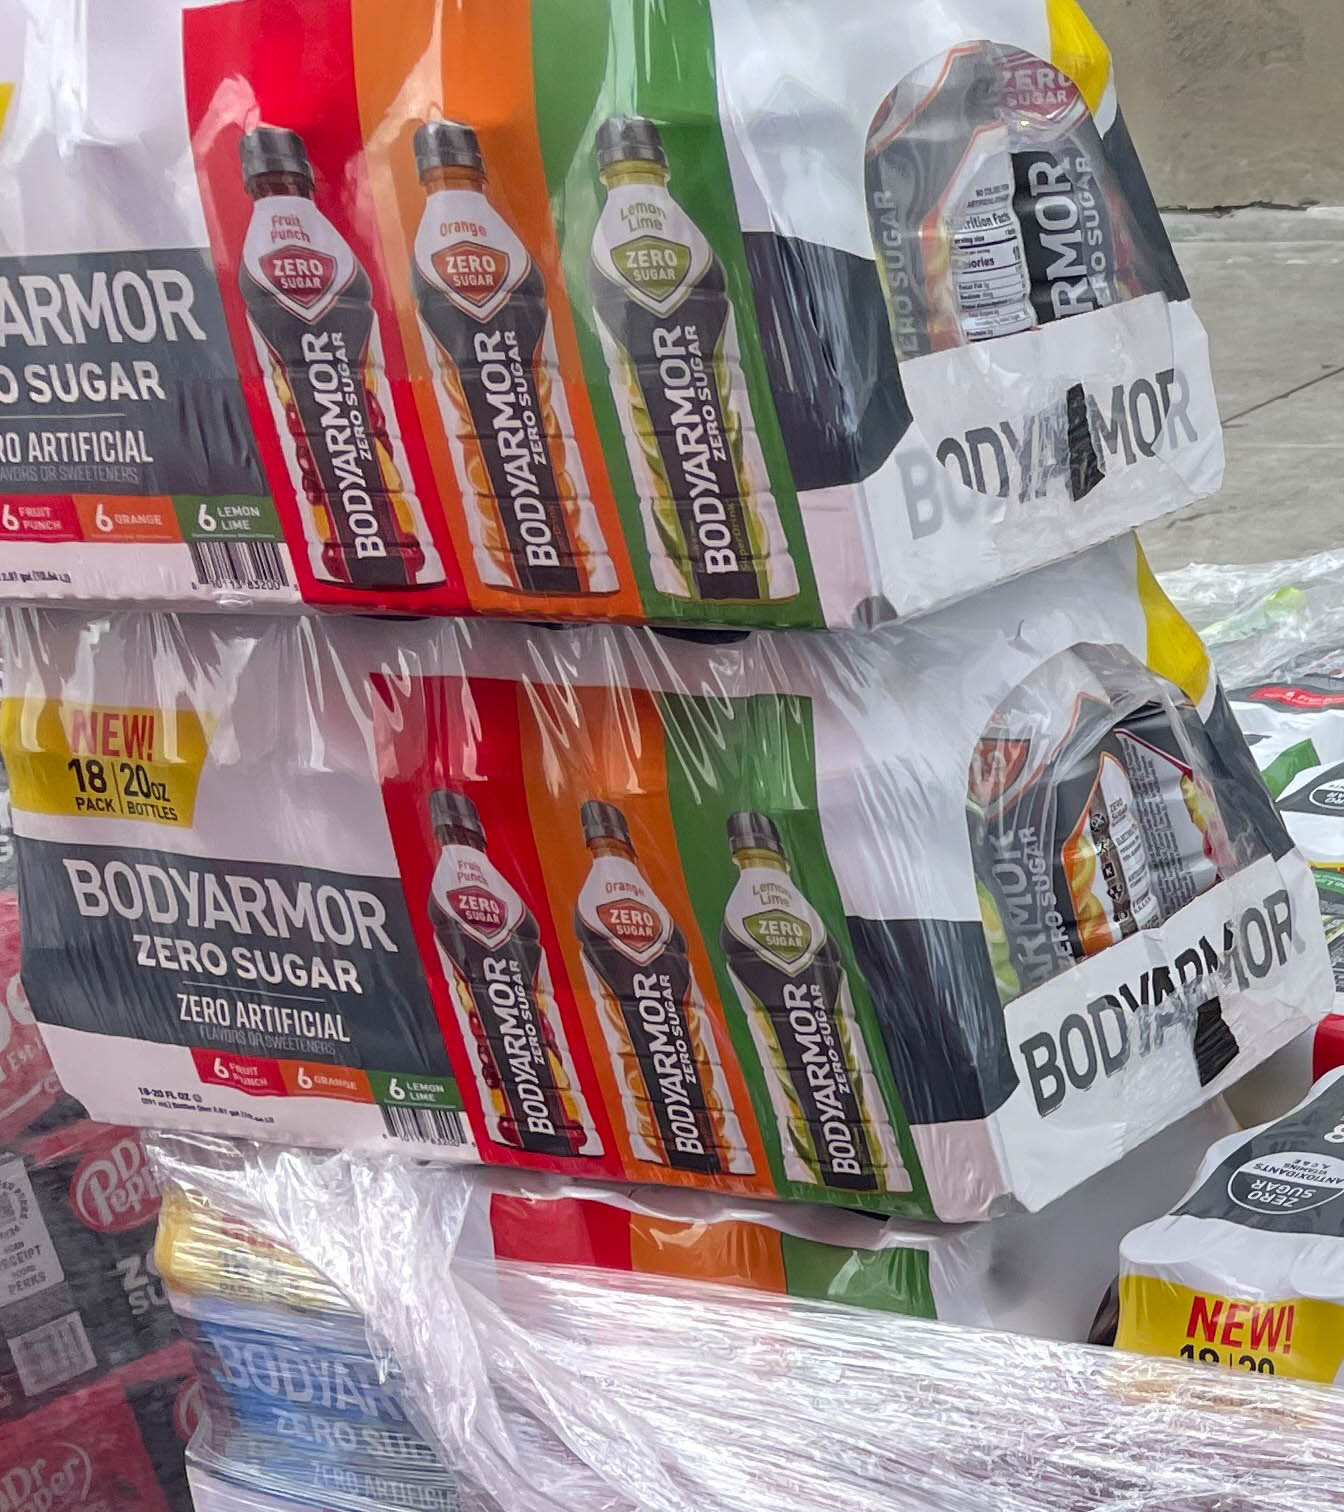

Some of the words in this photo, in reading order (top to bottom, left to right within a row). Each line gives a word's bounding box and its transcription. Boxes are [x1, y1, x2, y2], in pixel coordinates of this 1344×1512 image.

[620, 202, 667, 221] Lemon
[1074, 157, 1103, 246] SUGAR
[439, 220, 487, 238] Orange
[628, 216, 664, 232] Lime
[272, 258, 324, 276] ZERO
[446, 255, 497, 274] ZERO
[626, 249, 677, 268] ZERO
[280, 276, 322, 289] SUGAR
[452, 274, 494, 287] SUGAR
[632, 269, 676, 282] SUGAR
[332, 331, 359, 407] SUGAR
[503, 331, 532, 408] SUGAR
[687, 325, 713, 403] SUGAR
[24, 361, 167, 402] SUGAR
[28, 430, 154, 463] ARTIFICIAL
[301, 331, 387, 560] BODYARMOR
[349, 410, 373, 461] ZERO
[474, 331, 560, 568] BODYARMOR
[522, 410, 548, 466] ZERO
[652, 324, 739, 575] BODYARMOR
[701, 406, 727, 463] ZERO
[60, 464, 140, 485] SWEETENERS
[2, 503, 19, 531] 6
[23, 520, 63, 531] PUNCH
[95, 503, 113, 532] 6
[115, 512, 164, 526] ORANGE
[198, 503, 217, 532] 6
[217, 505, 260, 518] LEMON
[221, 519, 252, 531] LIME
[71, 709, 155, 762] NEW!
[67, 758, 108, 795] 18
[75, 796, 116, 815] PACK
[126, 801, 179, 821] BOTTLES
[63, 858, 398, 953] BODYARMOR
[458, 894, 501, 915] ZERO
[465, 910, 501, 924] SUGAR
[608, 908, 654, 928] ZERO
[615, 923, 654, 937] SUGAR
[758, 920, 803, 940] ZERO
[765, 934, 803, 948] SUGAR
[133, 933, 227, 977] ZERO
[234, 948, 364, 995] SUGAR
[508, 959, 535, 1022] SUGAR
[177, 992, 229, 1027] ZERO
[236, 1001, 351, 1043] ARTIFICIAL
[655, 974, 682, 1039] SUGAR
[809, 983, 845, 1047] SUGAR
[201, 1025, 246, 1045] FLAVORS
[265, 1034, 337, 1056] SWEETENERS
[483, 956, 556, 1136] BODYARMOR
[528, 1024, 547, 1066] ZERO
[212, 1058, 229, 1079] 6
[632, 972, 705, 1155] BODYARMOR
[674, 1040, 697, 1086] ZERO
[837, 1049, 856, 1096] ZERO
[297, 1067, 314, 1090] 6
[388, 1078, 406, 1101] 6
[406, 1081, 445, 1093] LEMON
[782, 982, 862, 1178] BODYARMOR
[409, 1092, 437, 1102] LIME
[1247, 1190, 1294, 1208] ZERO
[1250, 1178, 1317, 1200] SUGAR
[1185, 1295, 1295, 1355] NEW!
